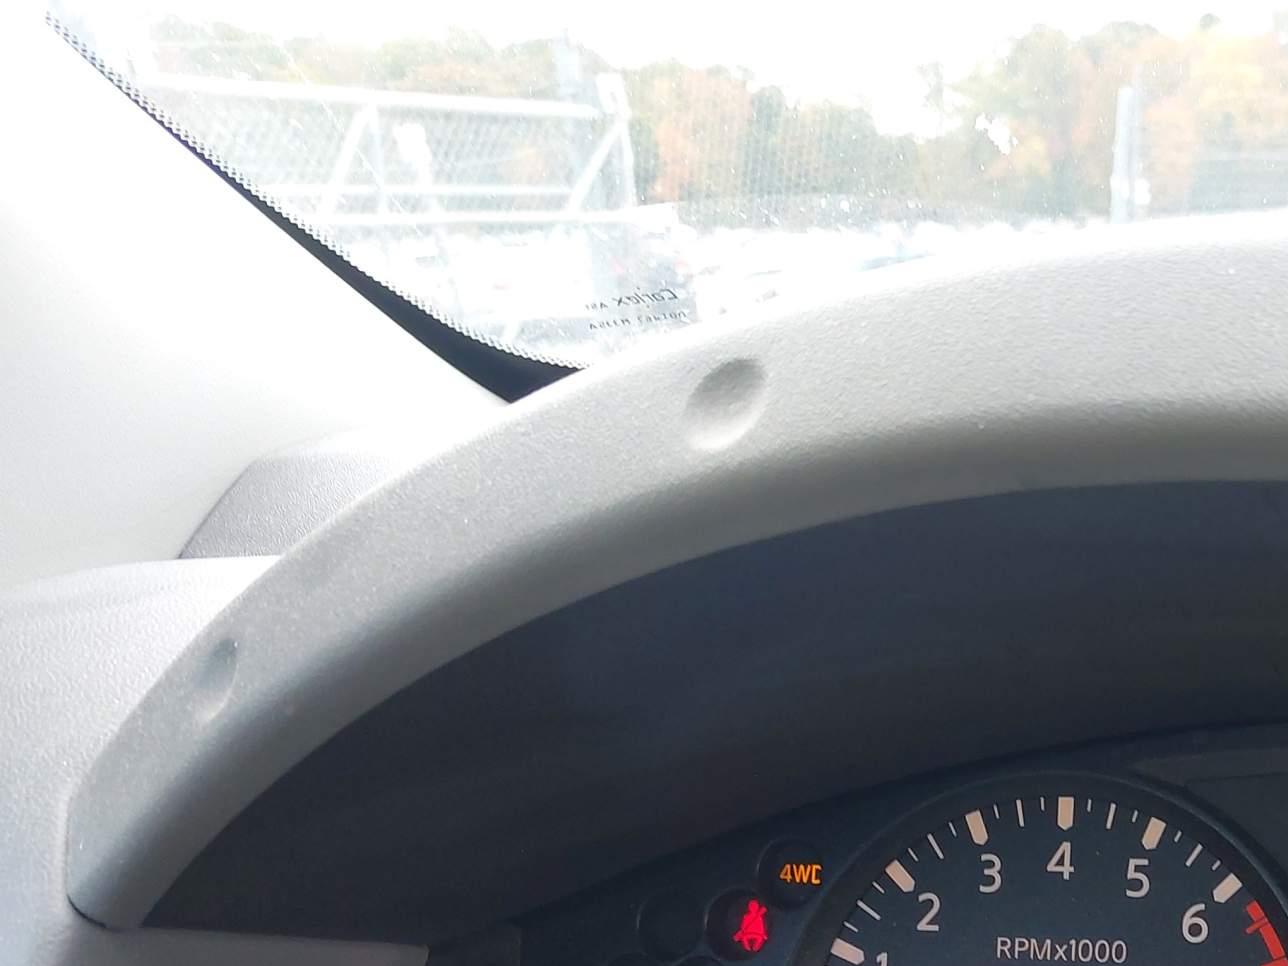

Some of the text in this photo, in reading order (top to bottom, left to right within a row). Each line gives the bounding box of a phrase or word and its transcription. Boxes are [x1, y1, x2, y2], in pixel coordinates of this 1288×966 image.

[979, 853, 1002, 893] 3
[1047, 842, 1075, 880] 4
[1125, 859, 1151, 898] 5
[916, 894, 941, 931] 2
[1181, 903, 1209, 943] 6
[995, 937, 1128, 964] RPMx1000
